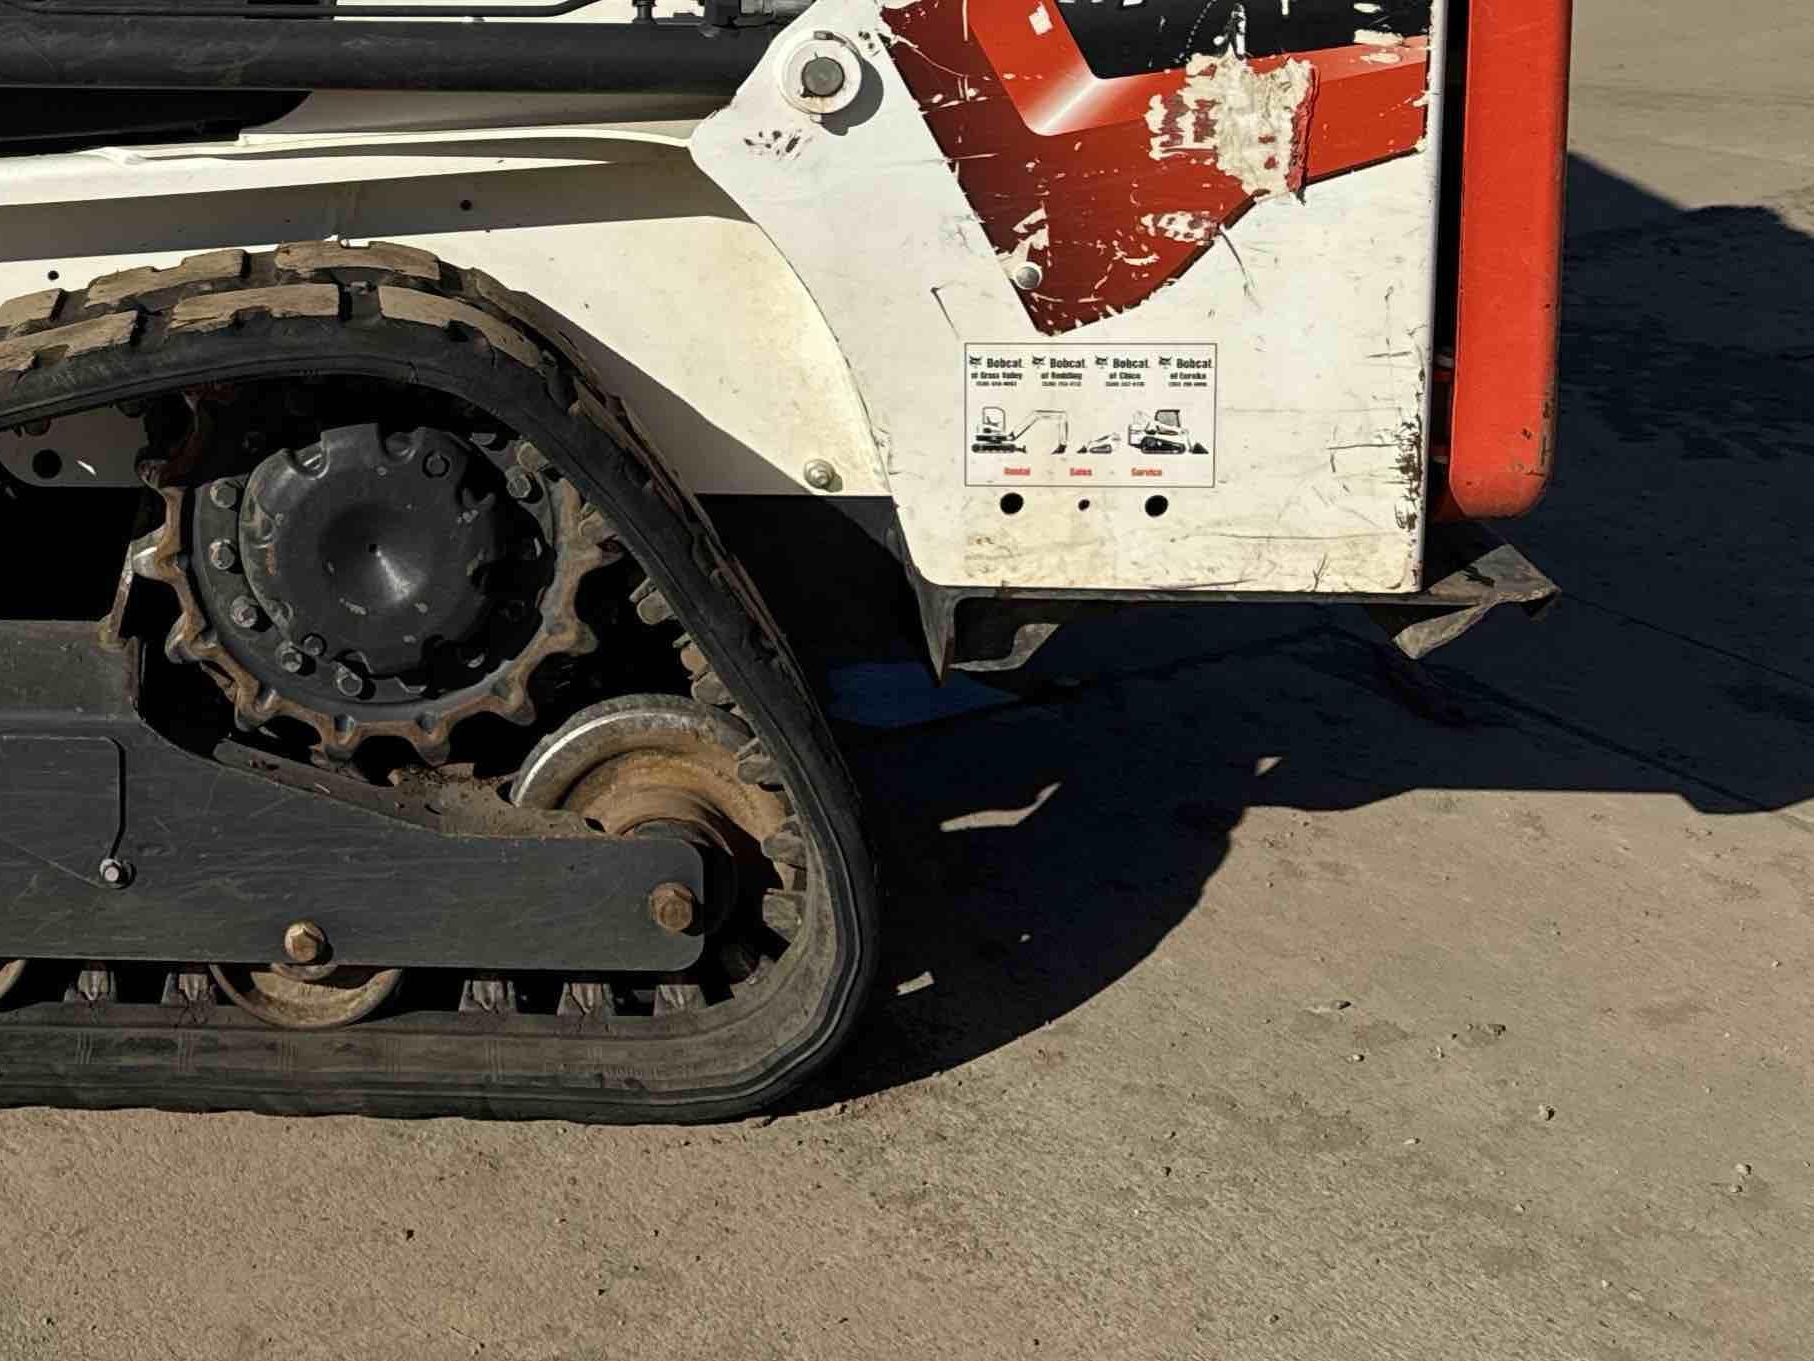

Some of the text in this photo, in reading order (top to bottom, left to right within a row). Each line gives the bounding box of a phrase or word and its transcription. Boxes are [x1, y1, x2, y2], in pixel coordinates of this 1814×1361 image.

[986, 357, 1022, 369] Bobcat
[1049, 357, 1085, 369] Bobcat
[1112, 357, 1148, 369] Bobcat
[1176, 357, 1212, 369] Bobcat
